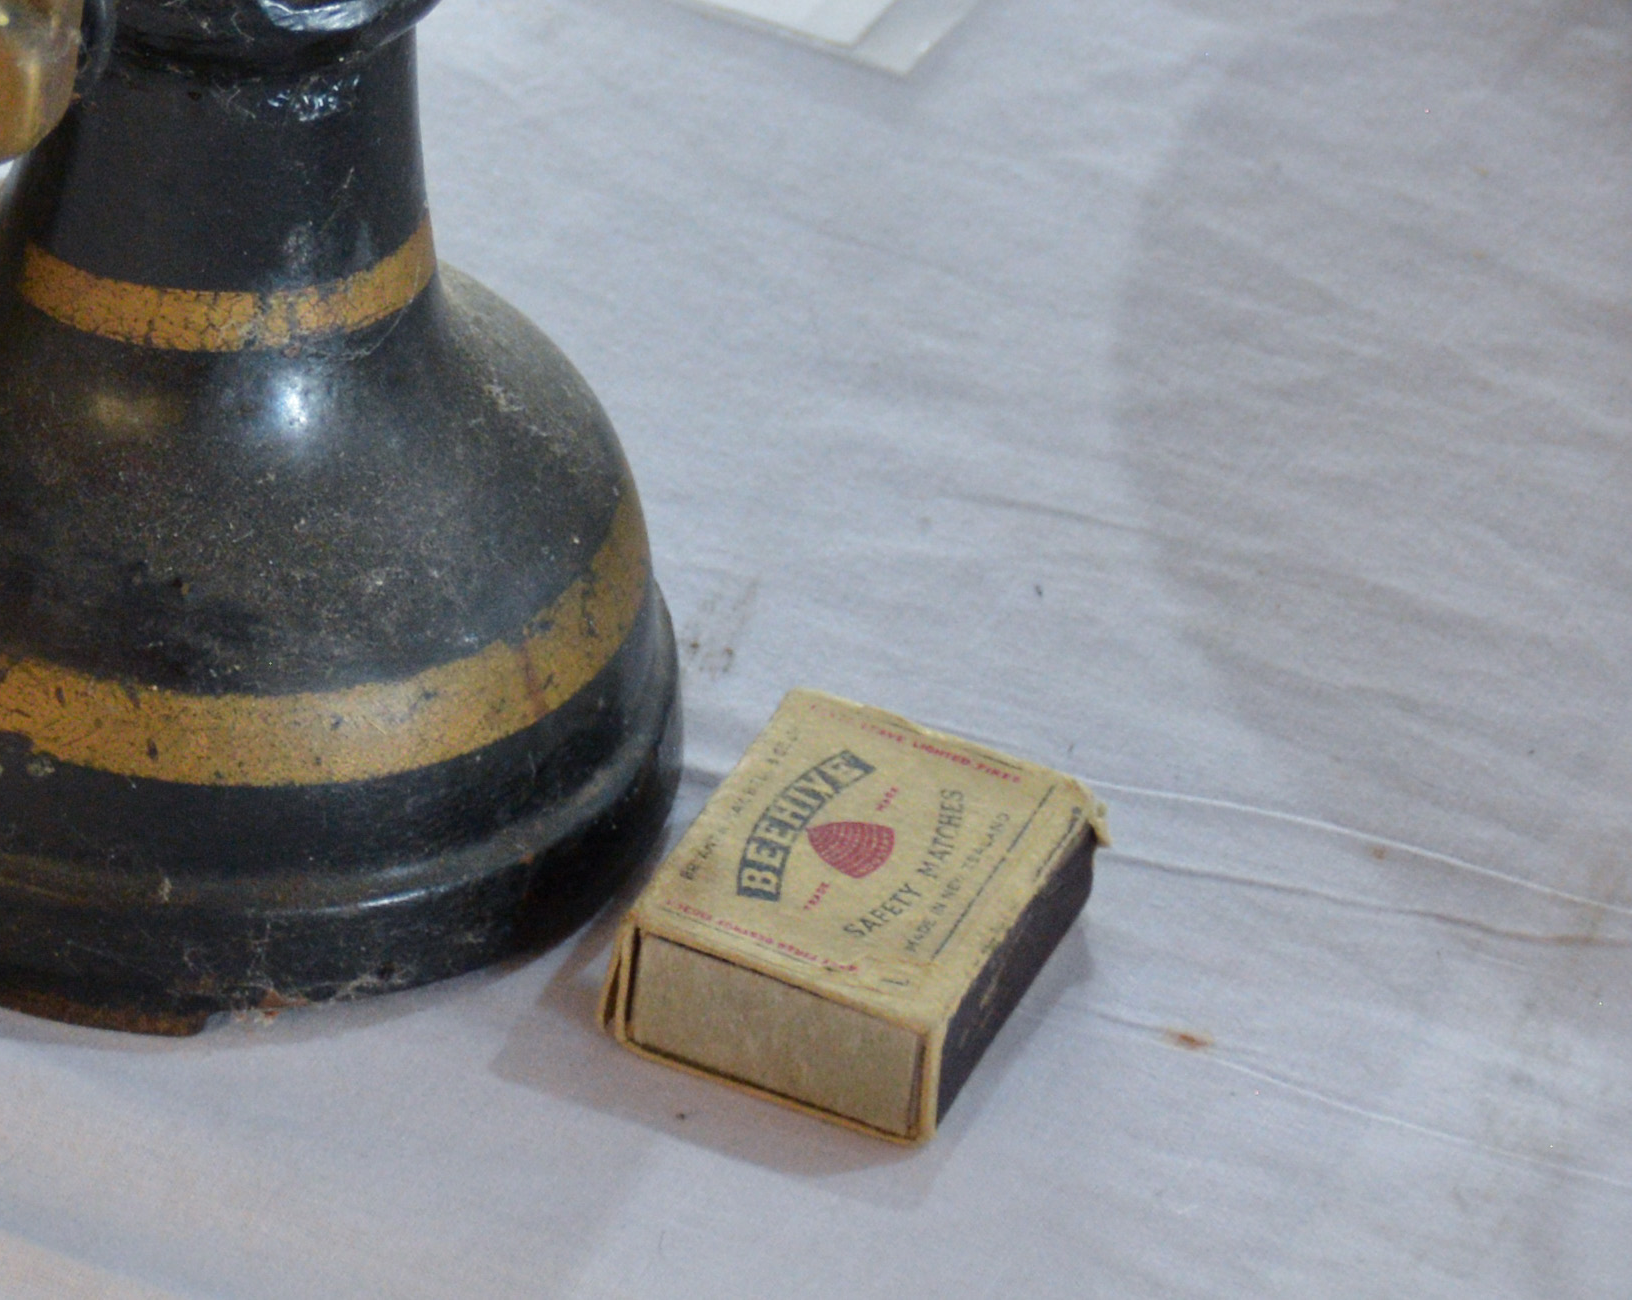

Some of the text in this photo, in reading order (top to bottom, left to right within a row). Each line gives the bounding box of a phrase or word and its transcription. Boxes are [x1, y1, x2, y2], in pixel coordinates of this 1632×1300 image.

[739, 753, 869, 894] BEEHIVE
[910, 738, 973, 766] LIGHTED
[974, 761, 1022, 783] FIRES
[801, 785, 900, 913] TRADE MARK
[841, 786, 963, 936] SAFETY MATCHES
[903, 916, 937, 954] MADE
[928, 900, 948, 916] IN
